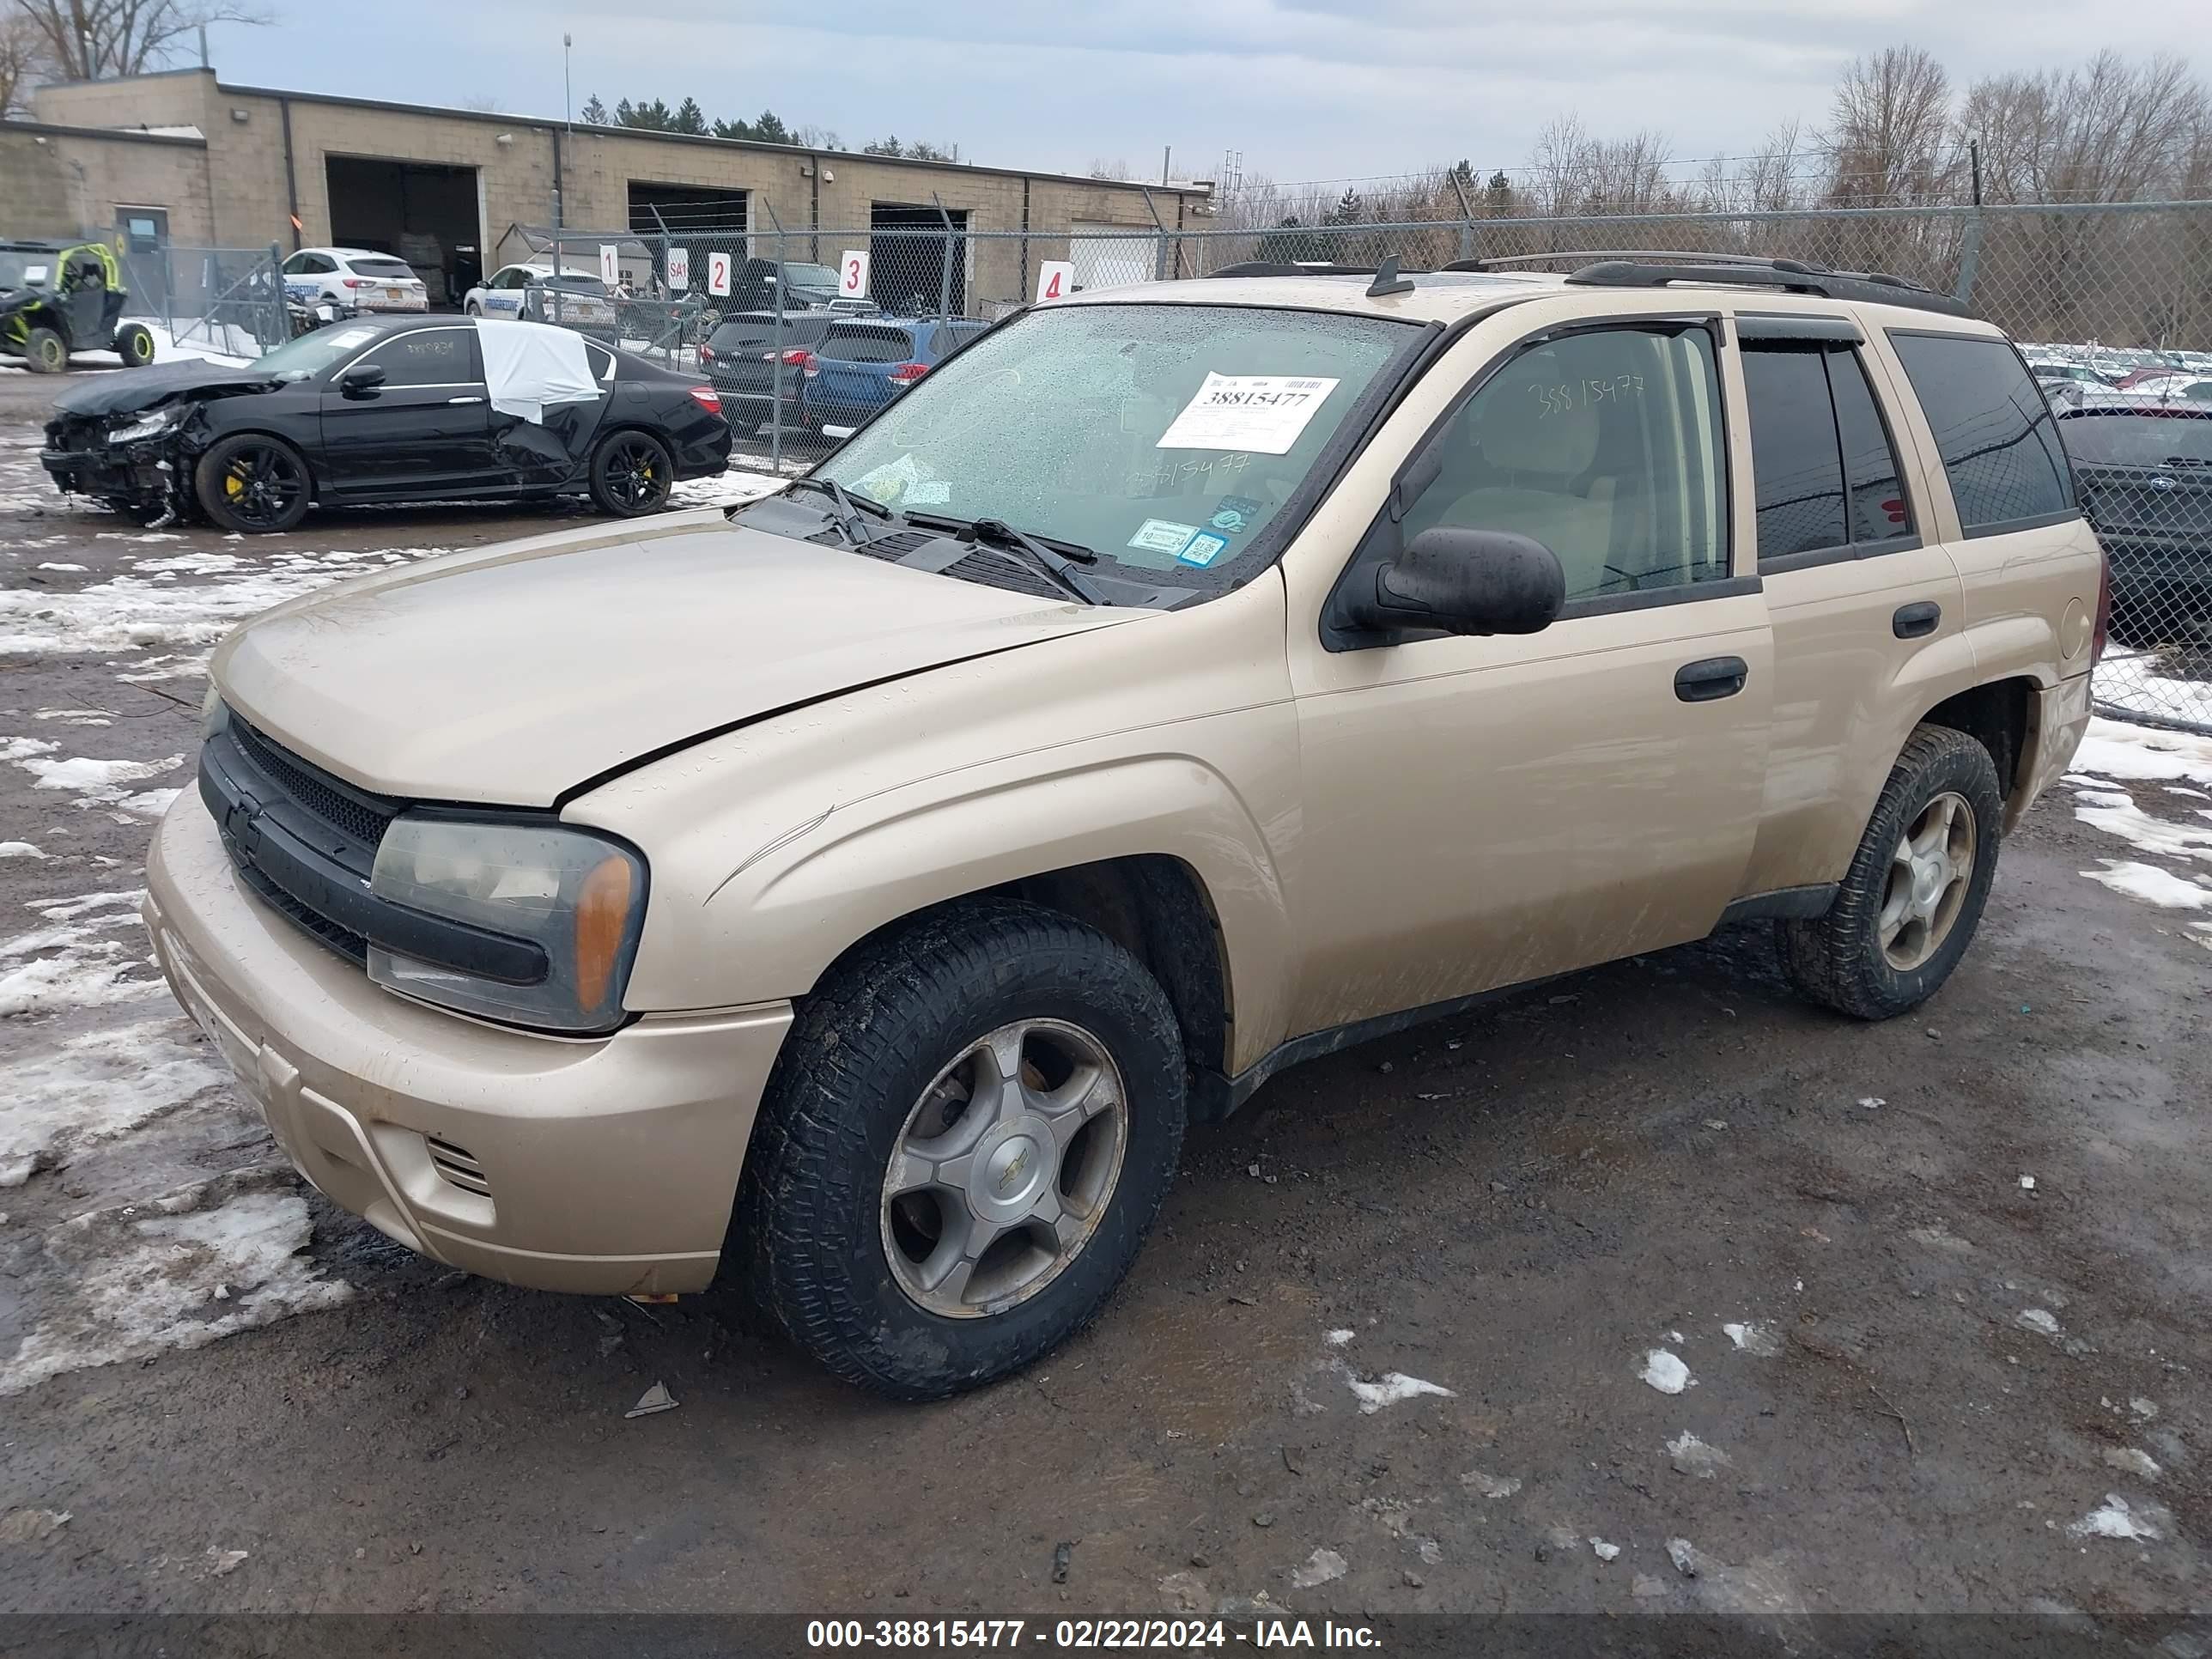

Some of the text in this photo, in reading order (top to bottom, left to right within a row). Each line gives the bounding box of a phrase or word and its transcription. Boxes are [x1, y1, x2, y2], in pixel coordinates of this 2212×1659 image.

[605, 252, 612, 278] 1
[670, 262, 687, 277] SA1
[714, 260, 725, 289] 2
[847, 259, 860, 290] 3
[1045, 271, 1061, 299] 4
[1203, 392, 1311, 407] 38815477
